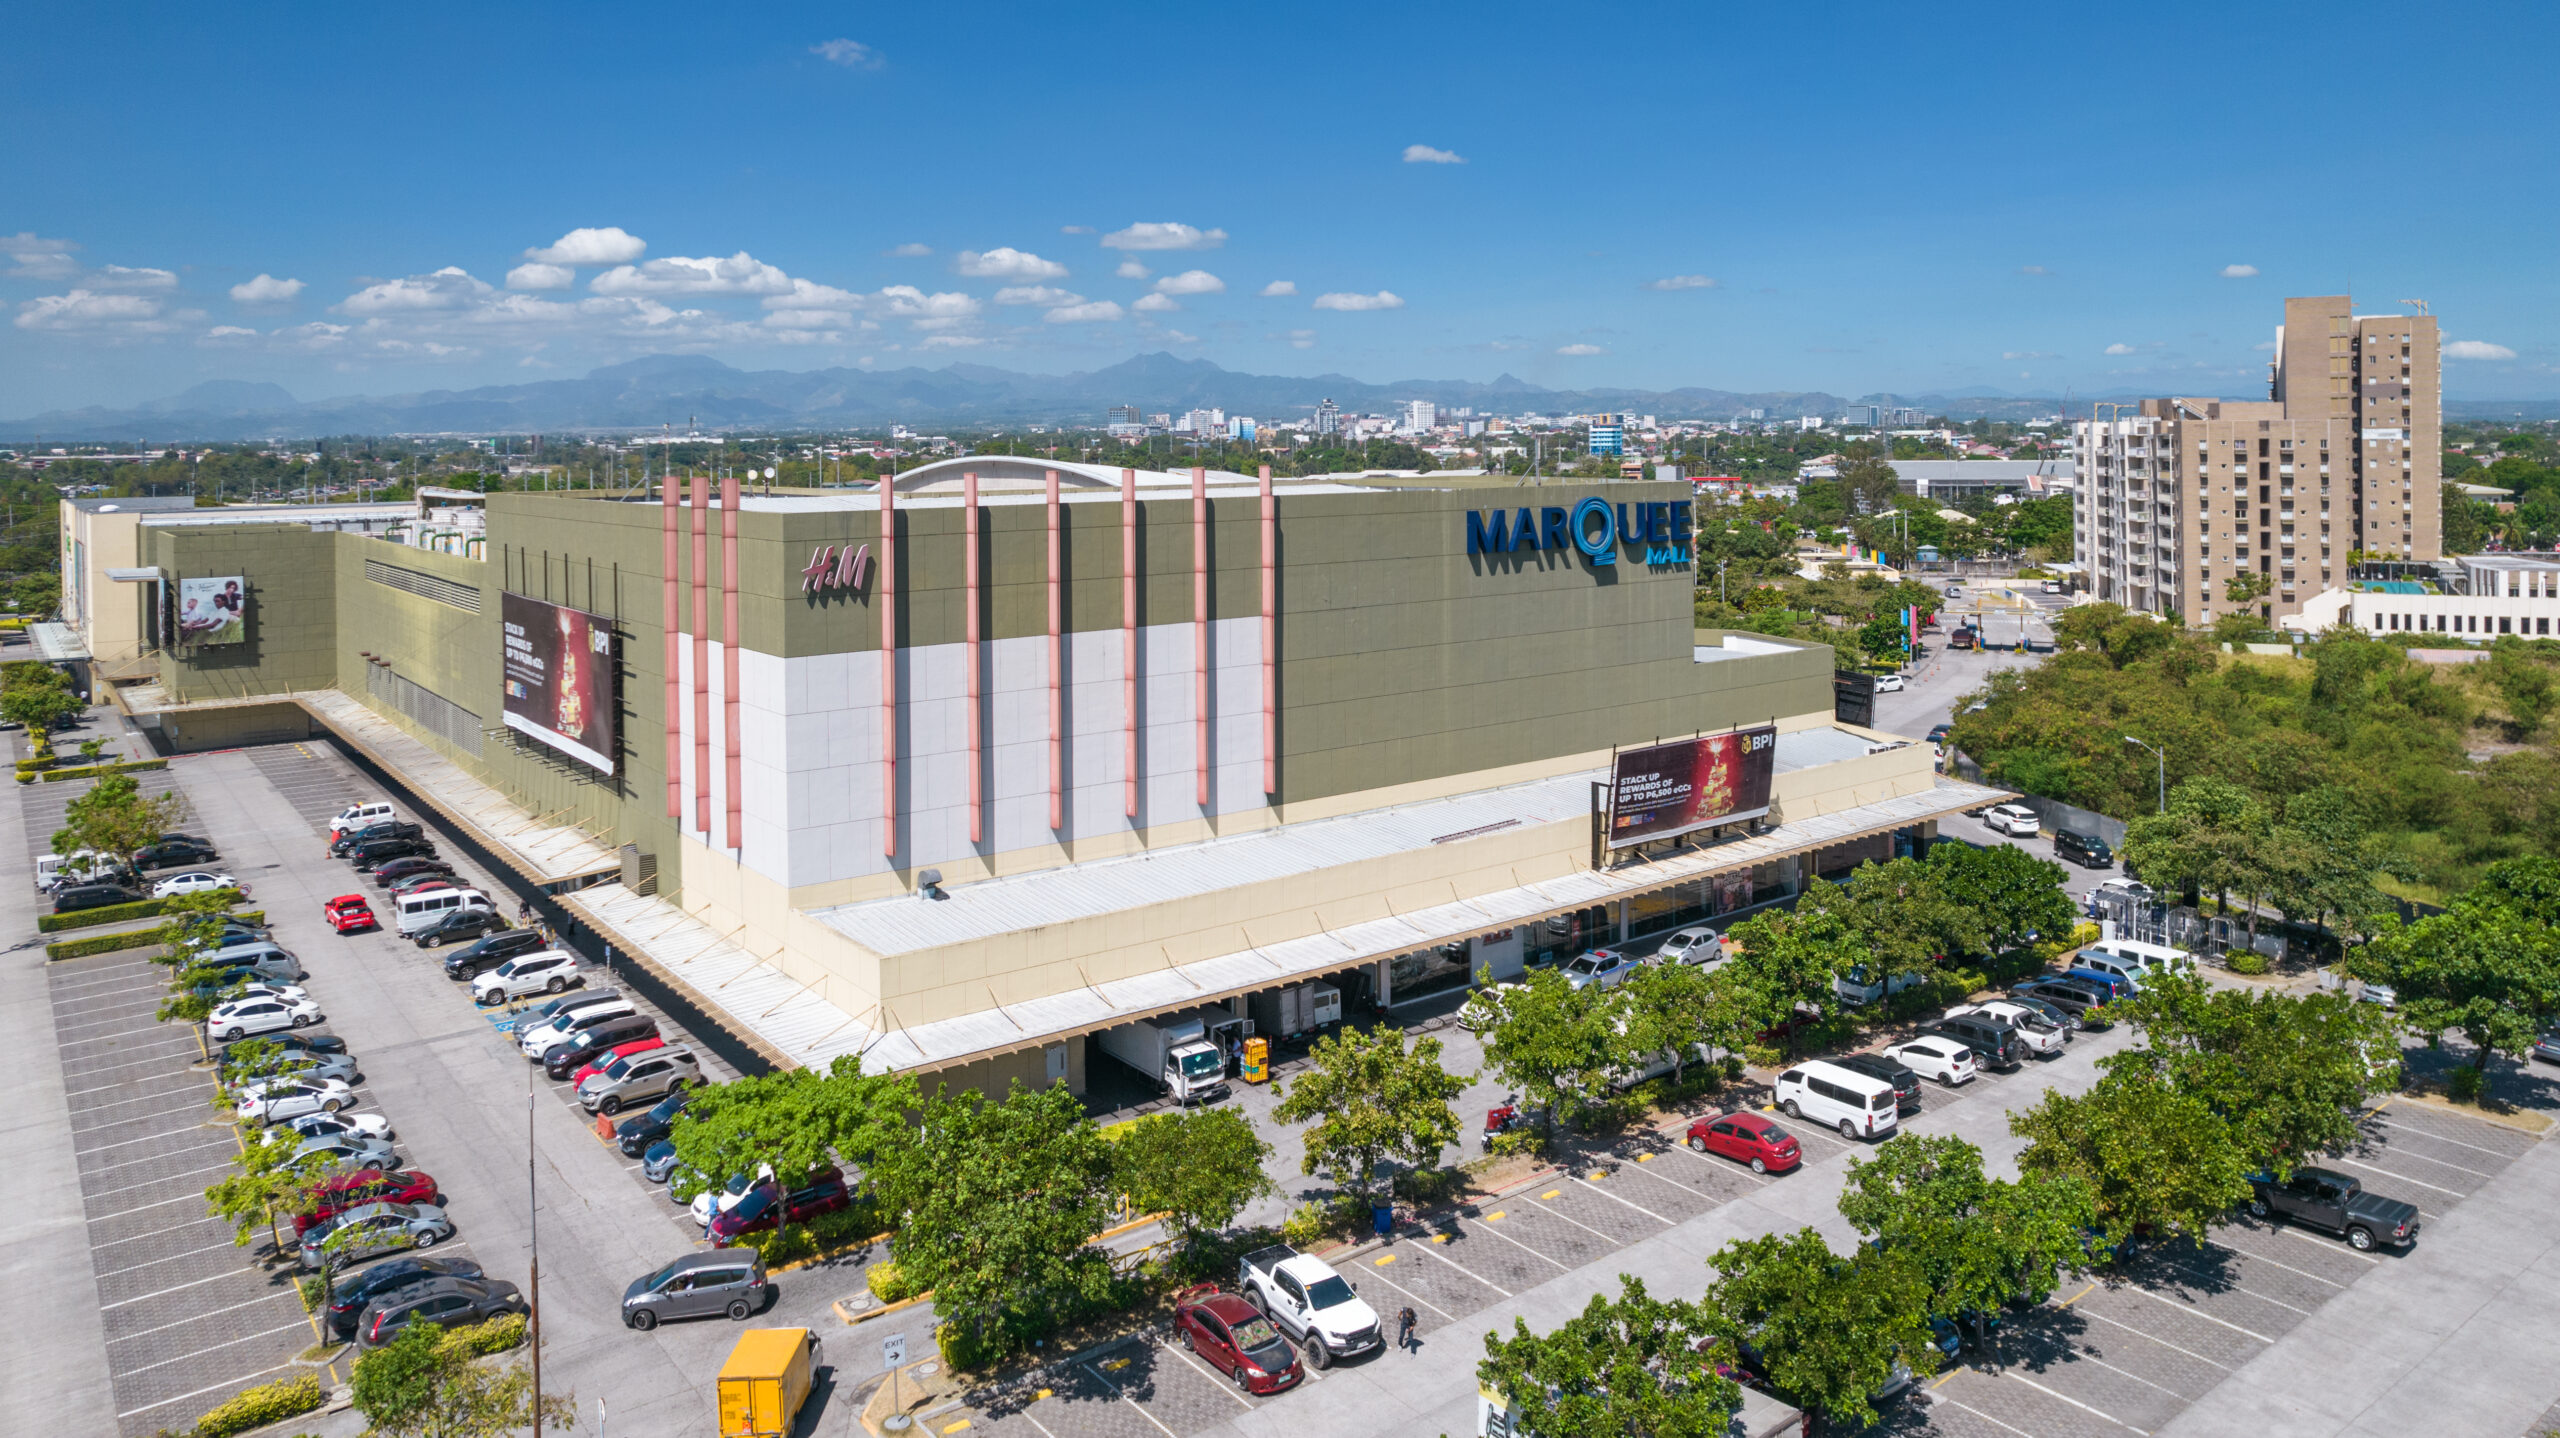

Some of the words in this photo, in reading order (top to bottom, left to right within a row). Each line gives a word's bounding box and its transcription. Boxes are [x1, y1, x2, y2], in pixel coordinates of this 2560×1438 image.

[1467, 496, 1691, 566] MARQUEE
[1646, 546, 1691, 565] MALL
[801, 544, 869, 592] H&M
[594, 630, 609, 655] BPI
[1753, 733, 1773, 750] BPI
[1620, 774, 1648, 785] STACK
[1649, 772, 1660, 781] UP
[1620, 781, 1661, 794] REWARDS
[1662, 778, 1673, 787] OF
[1619, 794, 1632, 802] UP
[1633, 792, 1644, 800] TO
[1646, 788, 1672, 798] P6,500
[885, 1338, 904, 1349] EXIT
